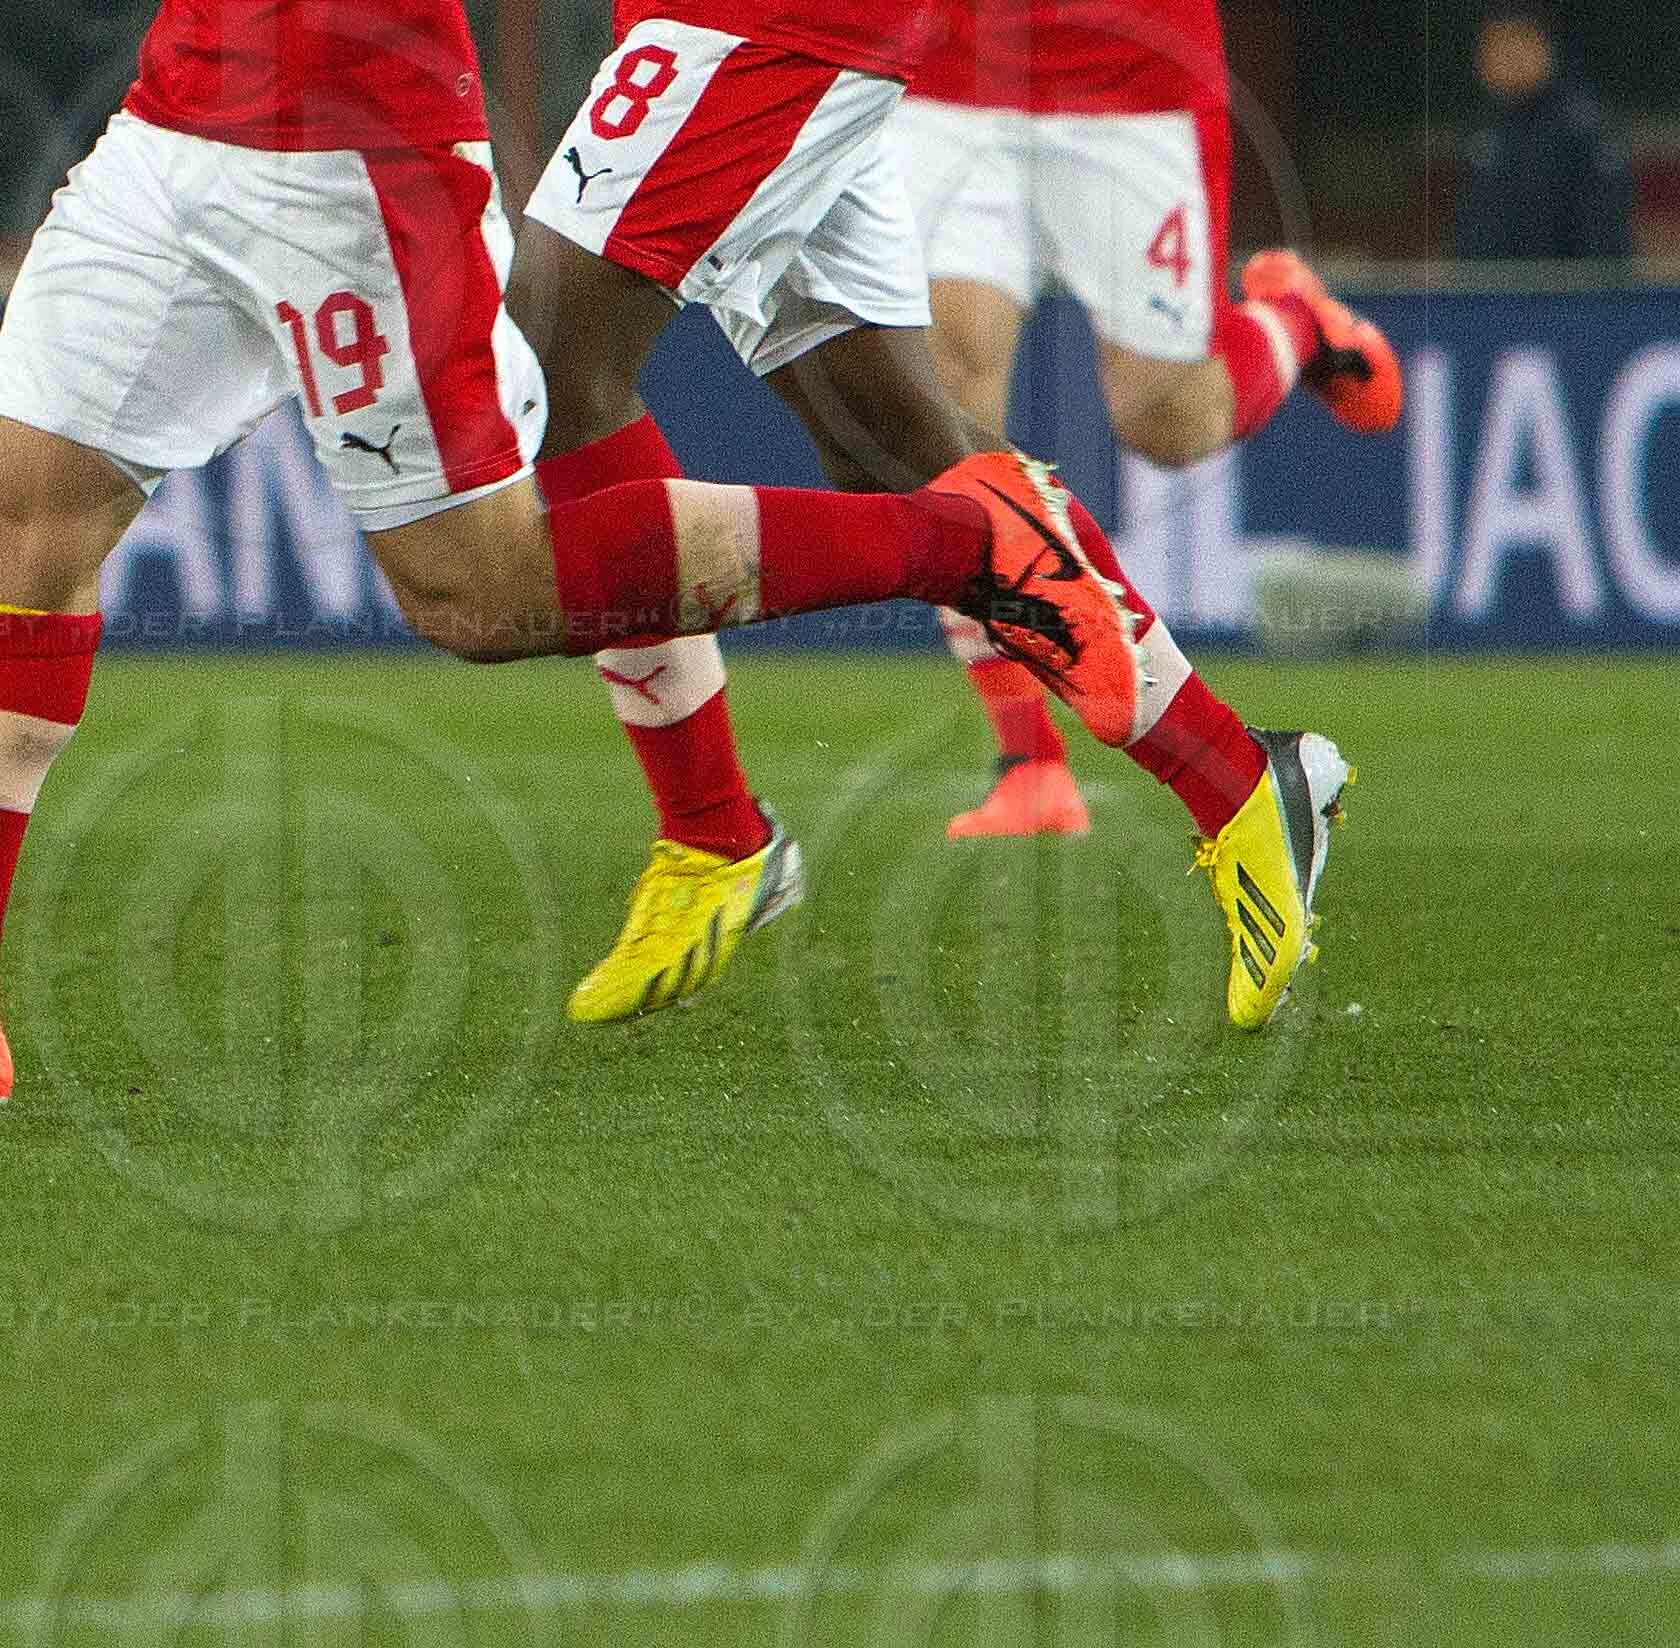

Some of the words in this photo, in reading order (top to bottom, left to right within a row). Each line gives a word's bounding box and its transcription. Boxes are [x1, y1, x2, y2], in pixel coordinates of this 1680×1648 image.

[590, 44, 680, 141] 8
[1146, 204, 1192, 289] 4
[275, 291, 391, 418] 19
